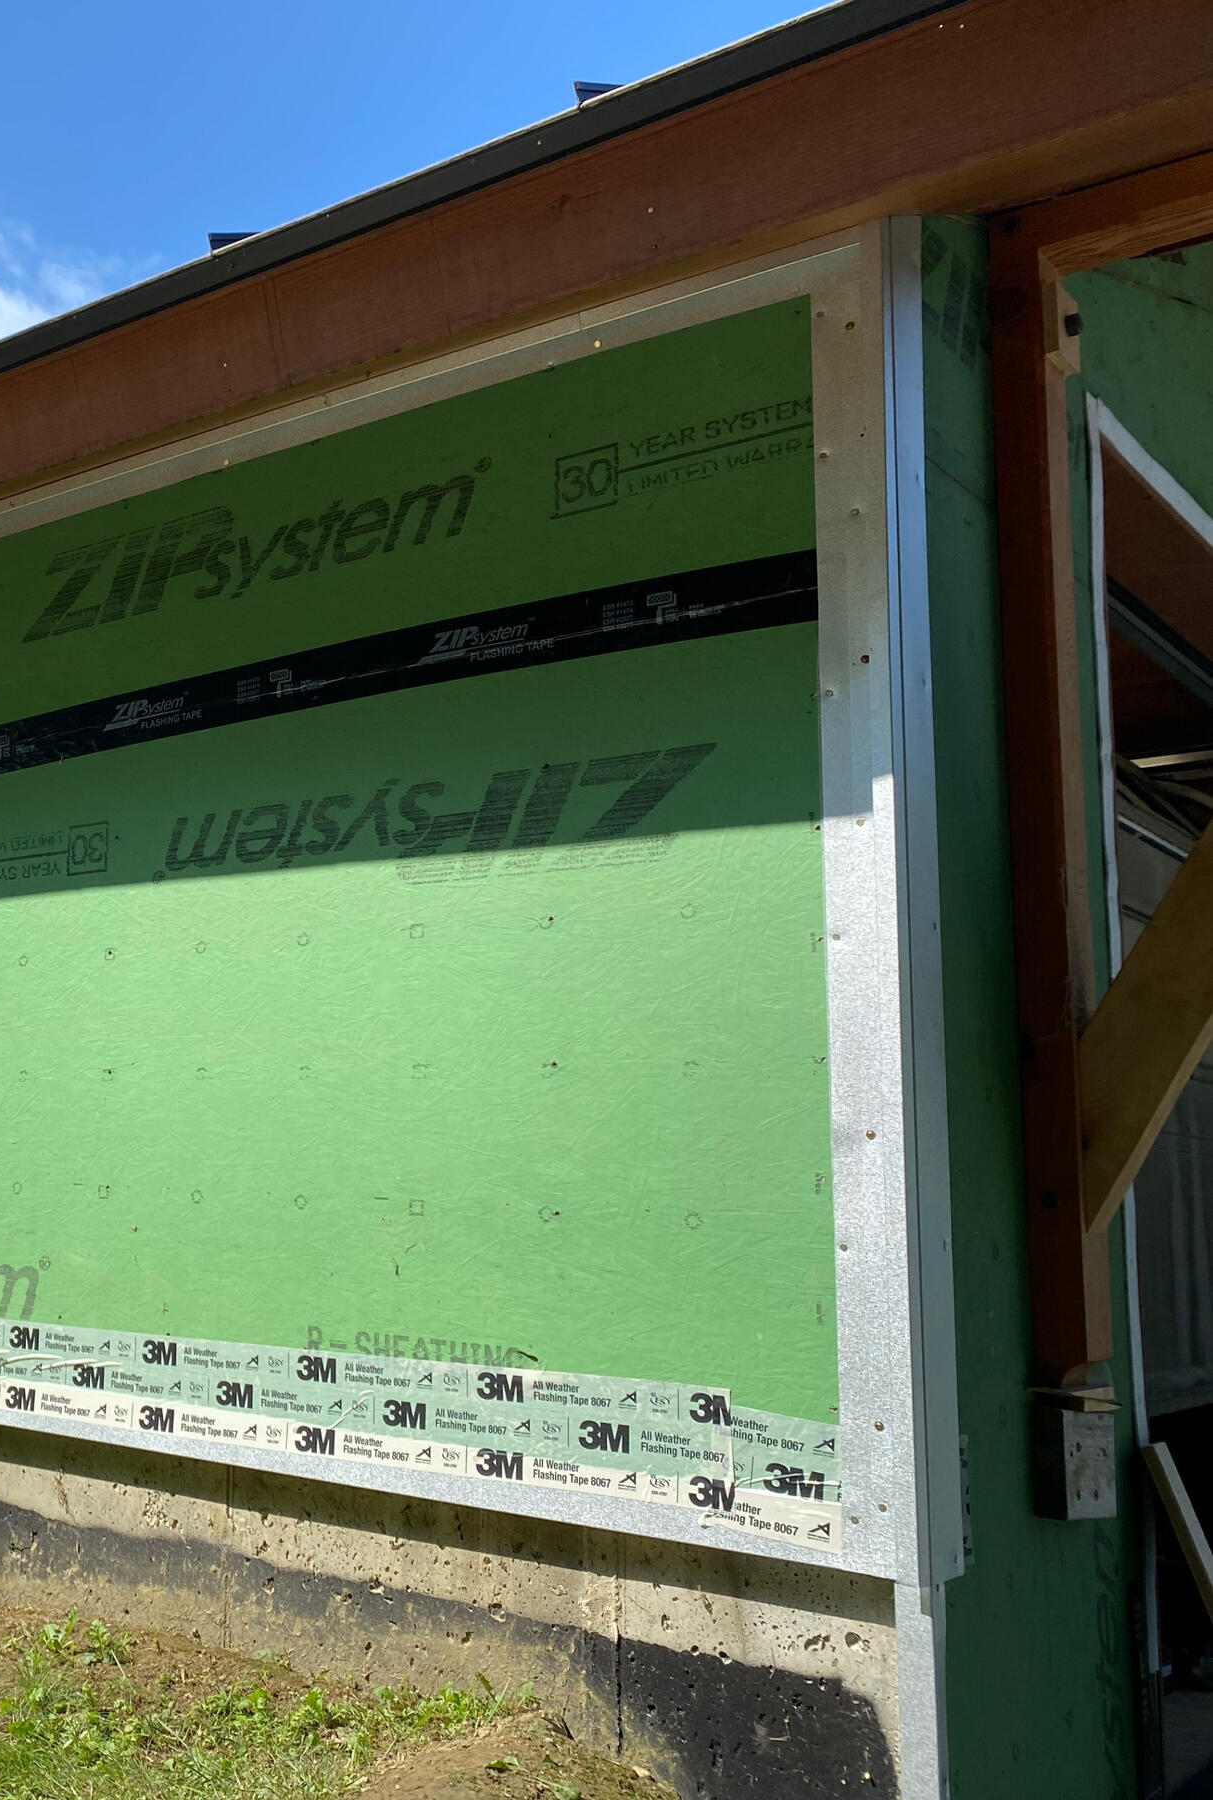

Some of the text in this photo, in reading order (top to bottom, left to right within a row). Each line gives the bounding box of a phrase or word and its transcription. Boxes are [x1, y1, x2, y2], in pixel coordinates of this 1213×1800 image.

[629, 426, 696, 458] YEAR
[561, 457, 613, 504] 30
[469, 637, 555, 663] FLASHING TAPE
[140, 709, 203, 731] FLASHING TAPE
[71, 832, 105, 865] 30
[28, 862, 61, 881] YEAR
[9, 1325, 40, 1350] 3M
[45, 1332, 74, 1342] All Weather
[45, 1339, 94, 1354] Flashing Tape 8067
[142, 1340, 177, 1366] 3M
[184, 1346, 218, 1358] All Weather
[15, 1367, 27, 1375] 8067
[184, 1356, 240, 1370] Flashing Tape 8067
[296, 1355, 337, 1384] 3M
[345, 1363, 384, 1374] All Weather
[72, 1364, 105, 1390] 3M
[111, 1371, 143, 1382] All Weather
[345, 1373, 411, 1388] Flashing Tape 8067
[111, 1379, 164, 1394] Flashing Tape 8067
[216, 1380, 253, 1409] 3M
[261, 1388, 298, 1400] All Weather
[476, 1372, 524, 1403] 3M
[533, 1380, 579, 1393] All Weather
[5, 1386, 36, 1412] 3M
[41, 1393, 71, 1404] All Weather
[261, 1398, 322, 1414] Flashing Tape 8067
[533, 1392, 611, 1408] Flashing Tape 8067
[41, 1400, 90, 1416] Flashing Tape 8067
[382, 1399, 426, 1430] 3M
[436, 1408, 478, 1421] All Weather
[139, 1405, 175, 1433] 3M
[181, 1413, 215, 1425] All Weather
[435, 1419, 507, 1435] Flashing Tape 8067
[731, 1416, 768, 1433] Weather
[181, 1422, 238, 1438] Flashing Tape 8067
[579, 1420, 630, 1454] 3M
[641, 1430, 691, 1446] All Weather
[294, 1426, 336, 1456] 3M
[343, 1434, 383, 1447] All Weather
[756, 1433, 778, 1447] Tape
[781, 1441, 805, 1452] 8067
[343, 1445, 409, 1461] Flashing Tape 8067
[641, 1442, 725, 1463] Flashing Tape 8067
[476, 1448, 524, 1481] 3M
[533, 1458, 579, 1472] All Weather
[533, 1469, 611, 1488] Flashing Tape 8067
[763, 1462, 825, 1501] 3M
[688, 1475, 735, 1512] 3M
[735, 1502, 762, 1516] ather
[748, 1516, 771, 1530] Tape
[774, 1522, 799, 1536] 8067
